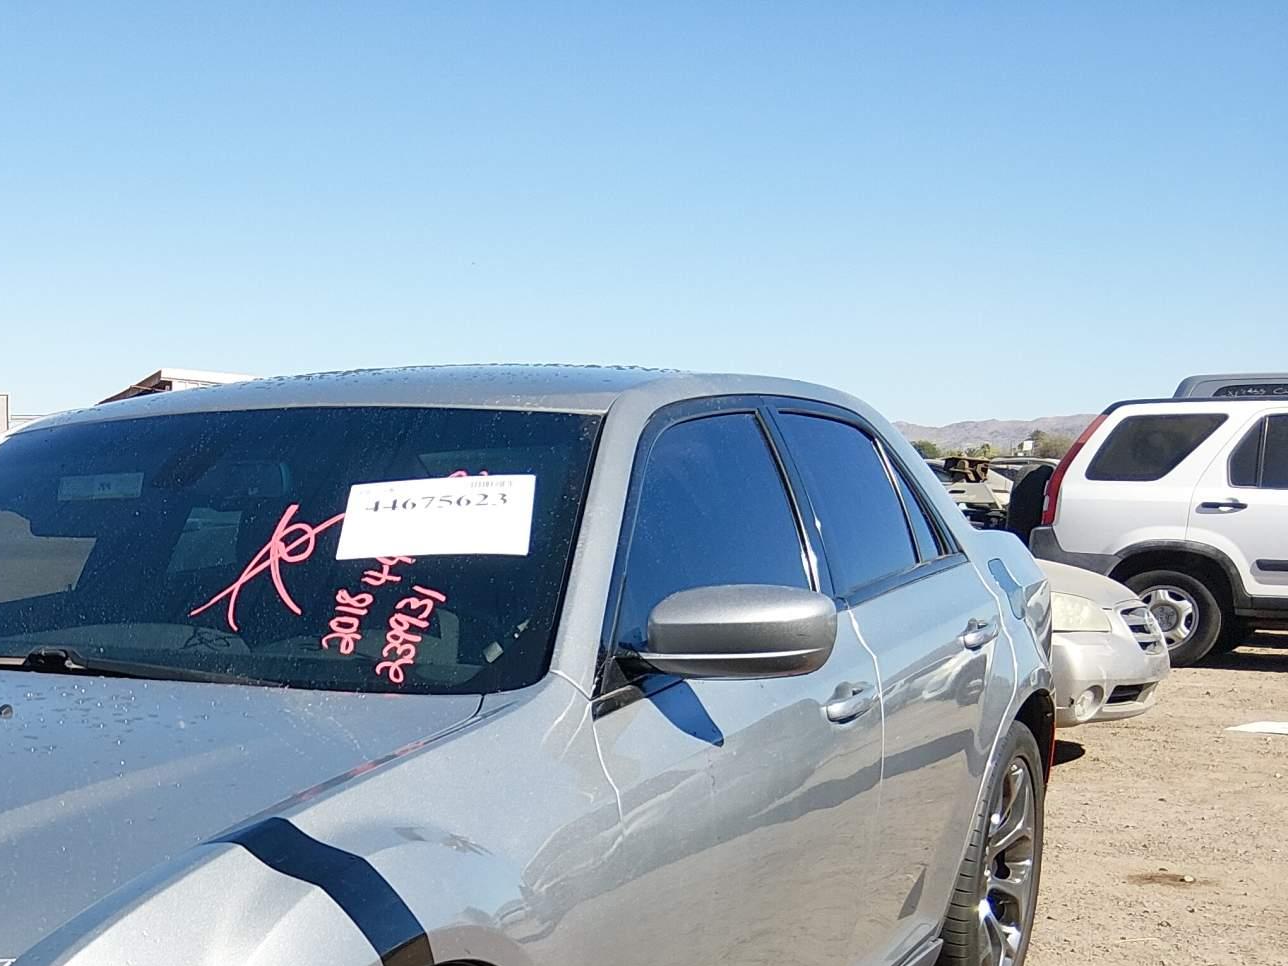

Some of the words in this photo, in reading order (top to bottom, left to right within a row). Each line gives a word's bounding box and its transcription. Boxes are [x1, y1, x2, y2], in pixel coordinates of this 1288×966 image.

[365, 493, 508, 512] 44675623
[321, 588, 374, 655] 2018
[375, 584, 447, 684] 239931
